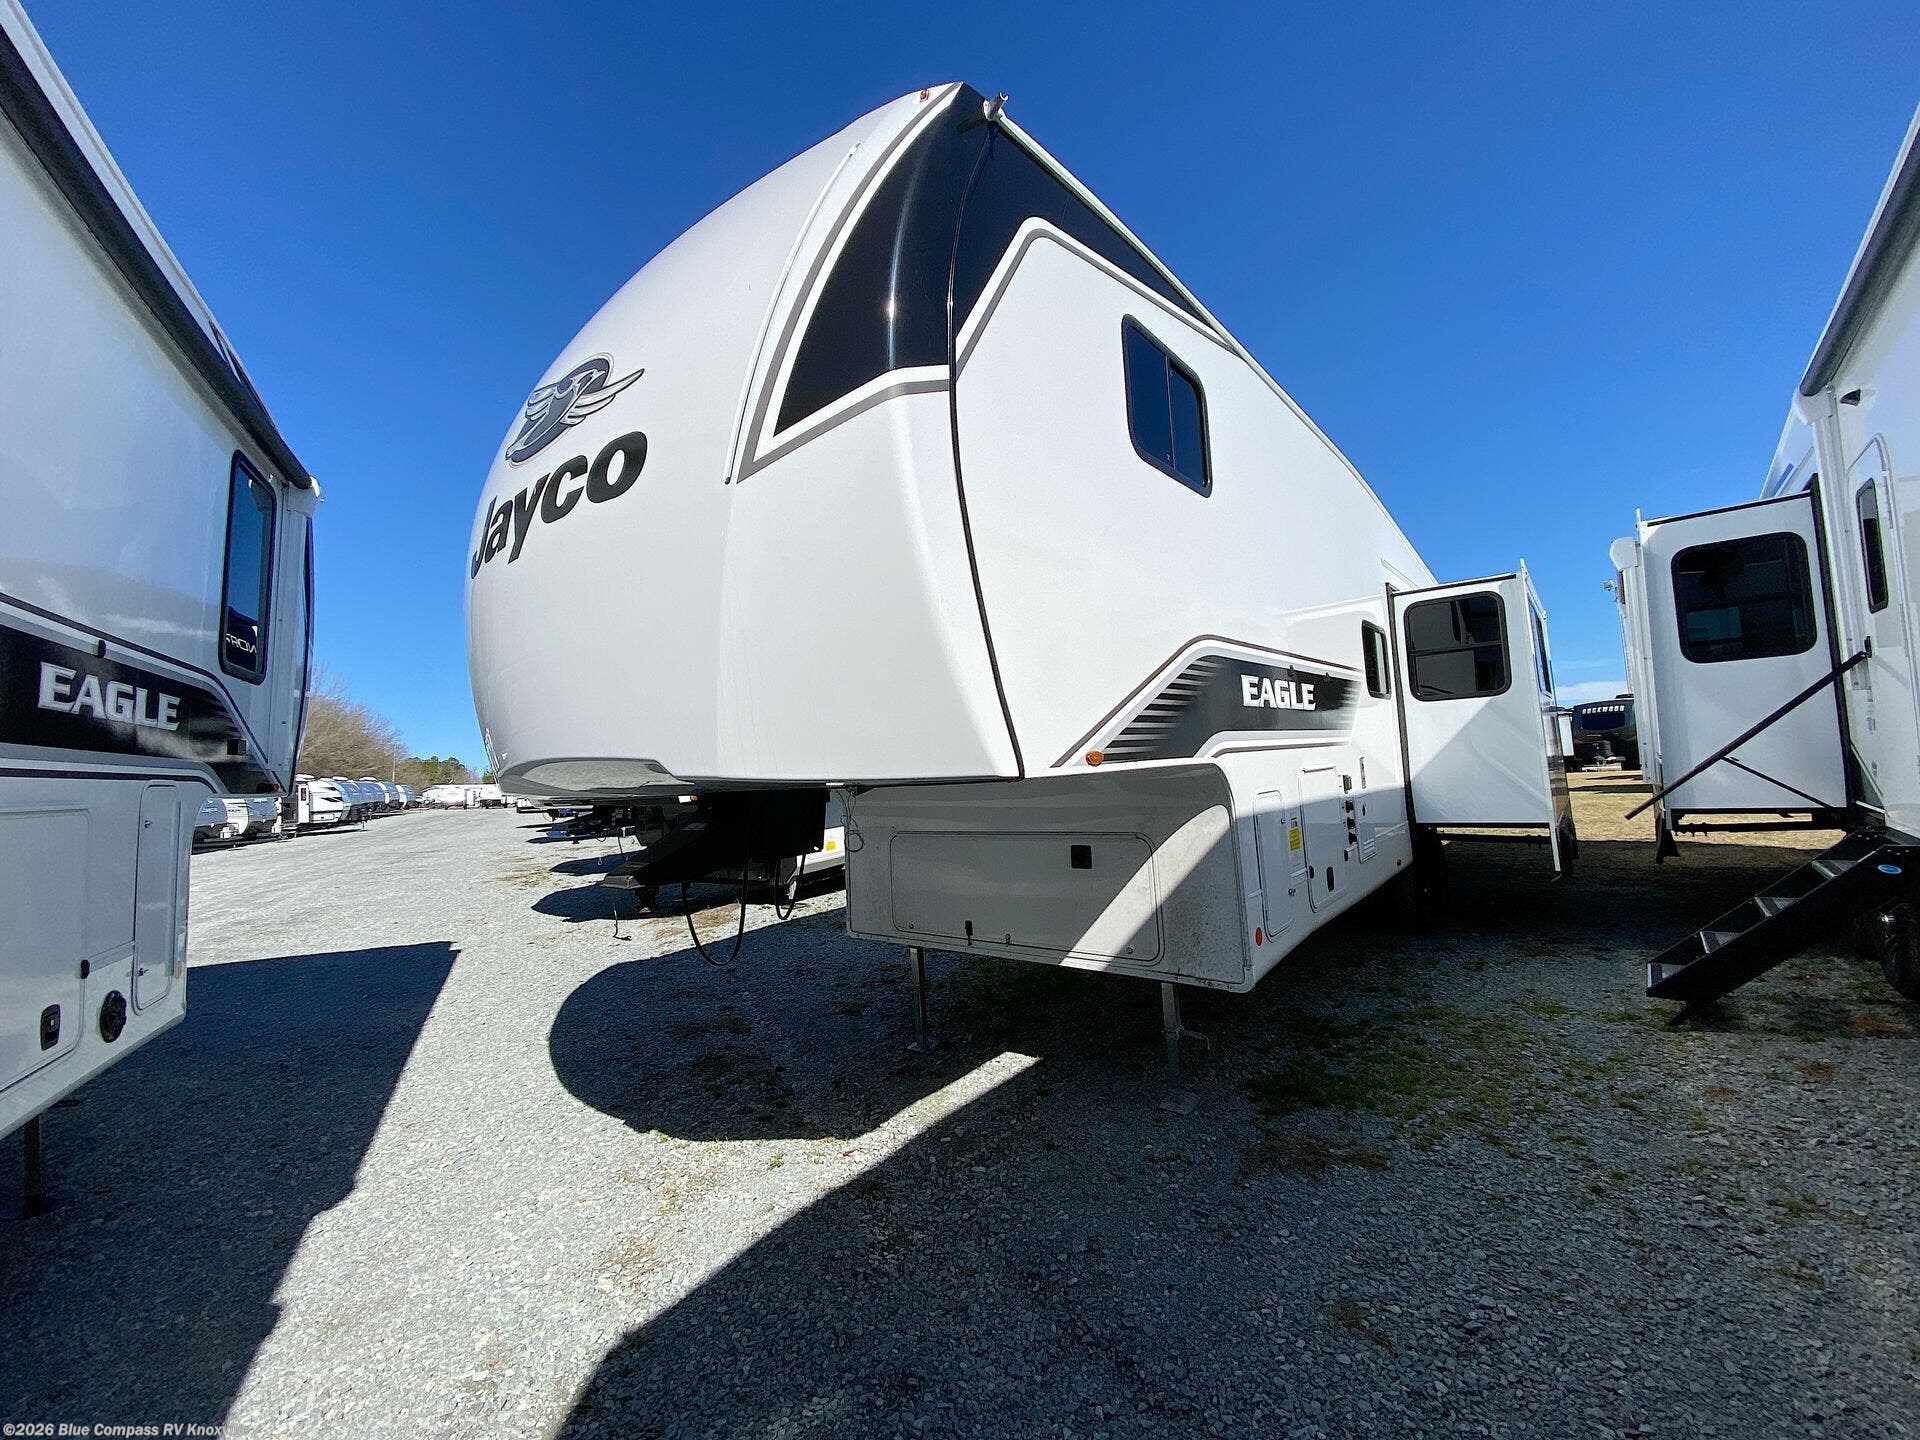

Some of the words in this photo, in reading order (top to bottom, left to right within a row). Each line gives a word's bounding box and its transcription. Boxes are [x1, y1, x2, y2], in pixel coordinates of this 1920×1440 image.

[471, 431, 647, 579] Jayco
[38, 662, 181, 731] EAGLE
[1241, 674, 1316, 711] EAGLE
